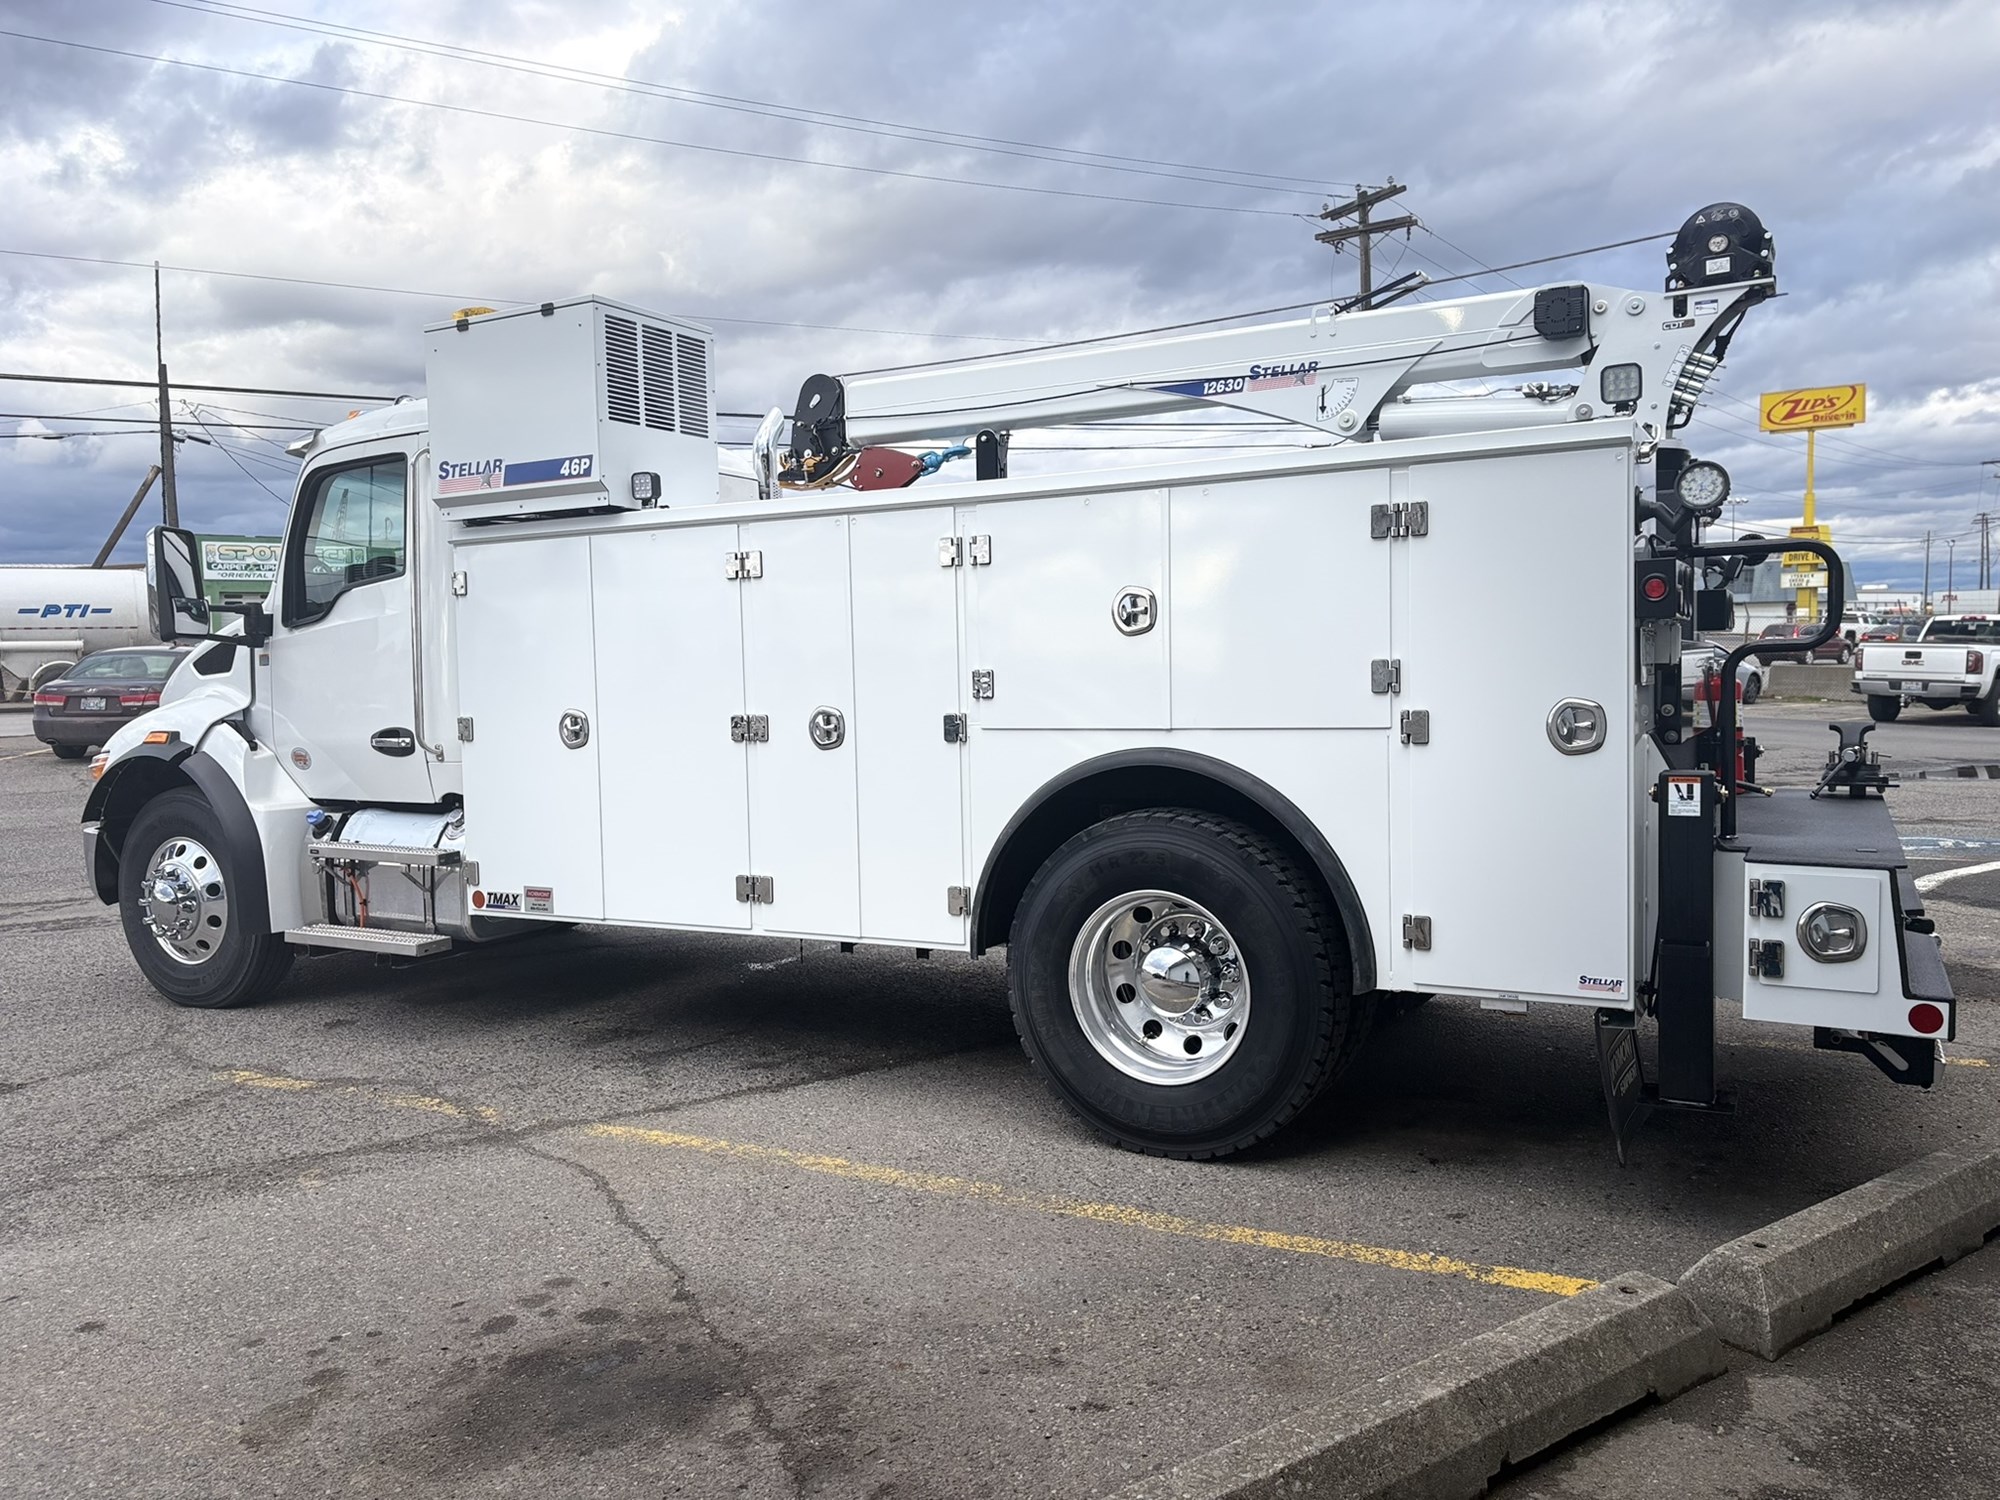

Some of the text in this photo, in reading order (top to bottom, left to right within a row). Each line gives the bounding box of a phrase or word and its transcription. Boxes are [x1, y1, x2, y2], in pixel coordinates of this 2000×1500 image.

[1249, 360, 1319, 380] STELLAR
[1203, 377, 1244, 395] 12630
[438, 458, 504, 480] STELLAR
[559, 458, 591, 477] 46P
[1788, 552, 1810, 561] DRIVE
[211, 563, 246, 571] CARPET
[487, 892, 521, 906] TMAX
[1578, 975, 1623, 988] STELLAR
